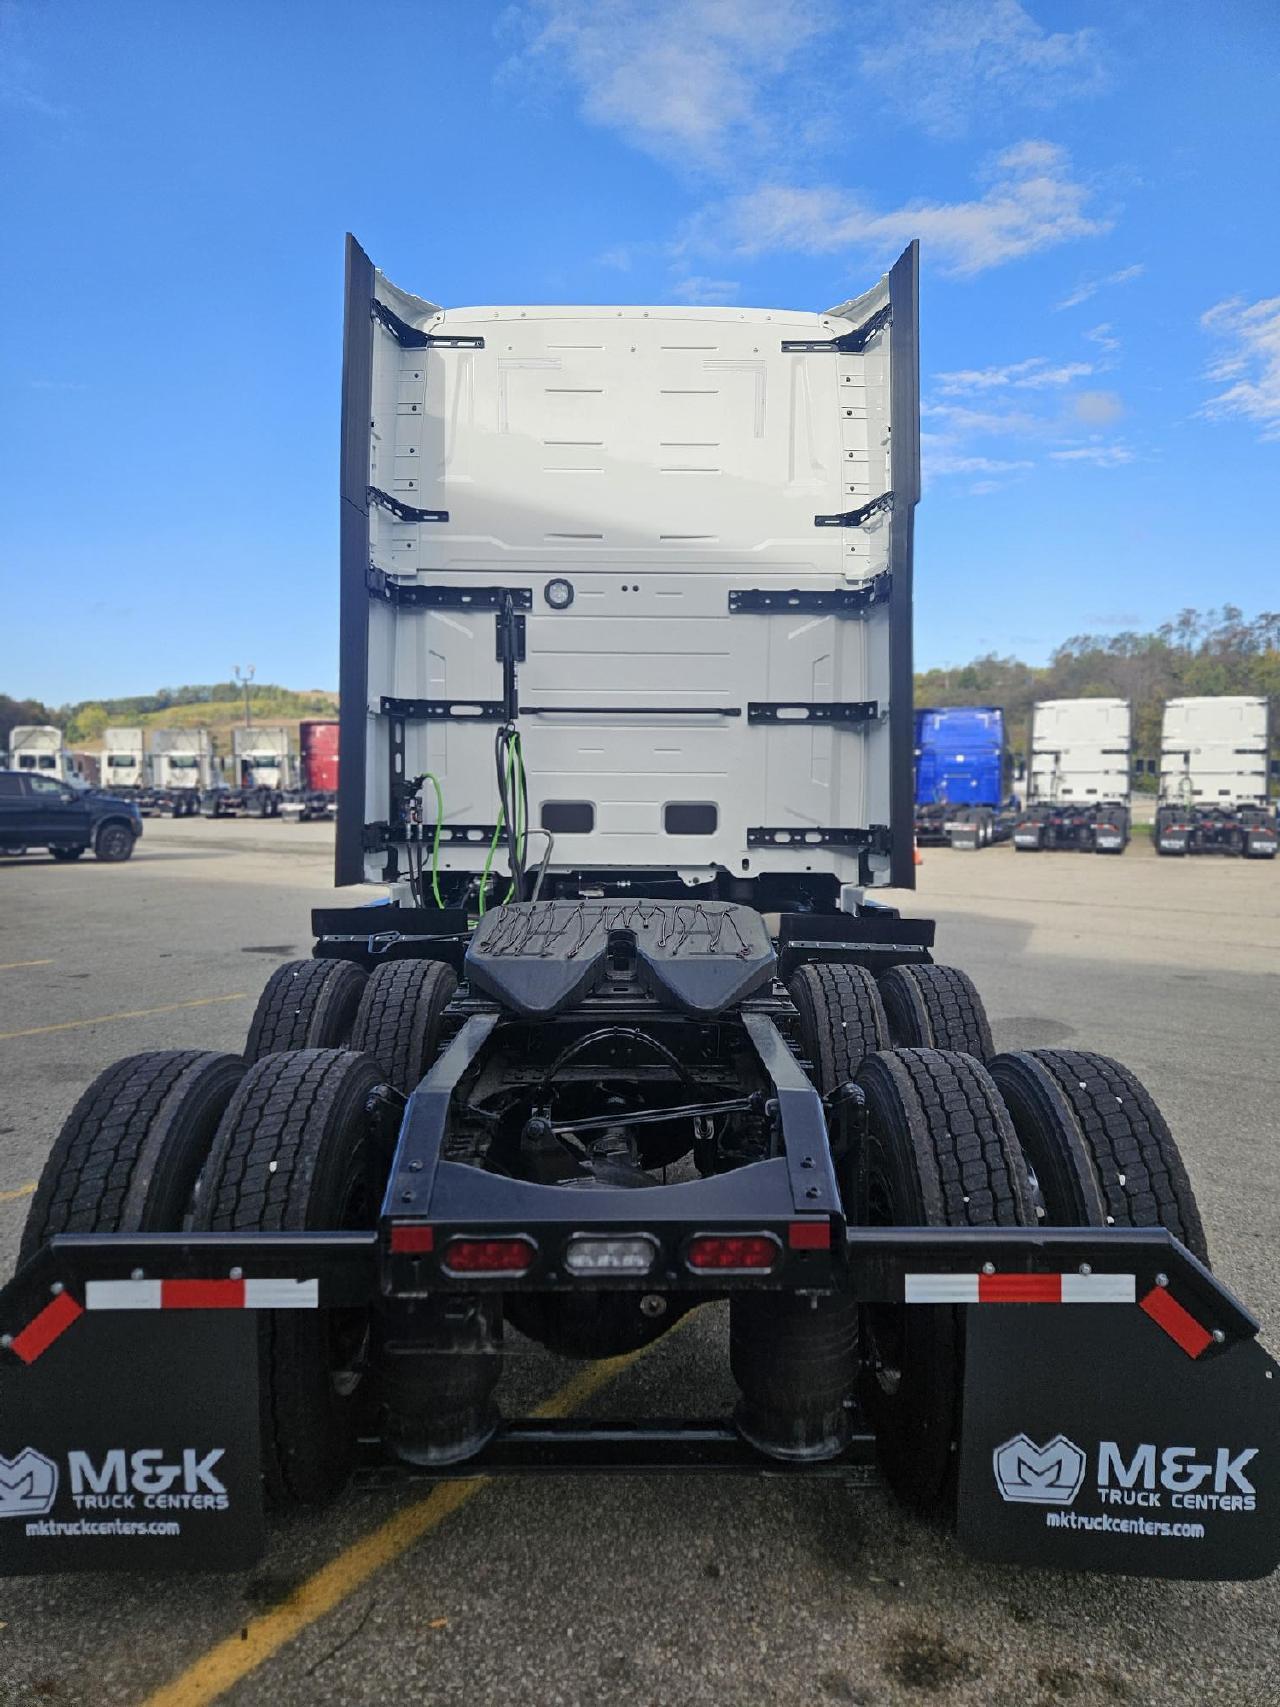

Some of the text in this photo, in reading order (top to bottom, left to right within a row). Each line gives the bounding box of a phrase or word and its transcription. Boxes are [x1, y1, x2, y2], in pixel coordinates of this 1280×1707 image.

[69, 1448, 227, 1494] M&K
[1097, 1441, 1259, 1494] M&K
[74, 1495, 229, 1510] TRUCK CENTERS
[1097, 1488, 1256, 1511] TRUCK CENTERS
[26, 1519, 180, 1536] mktruckcenters.com
[1046, 1511, 1205, 1538] mktruckcenters.com
